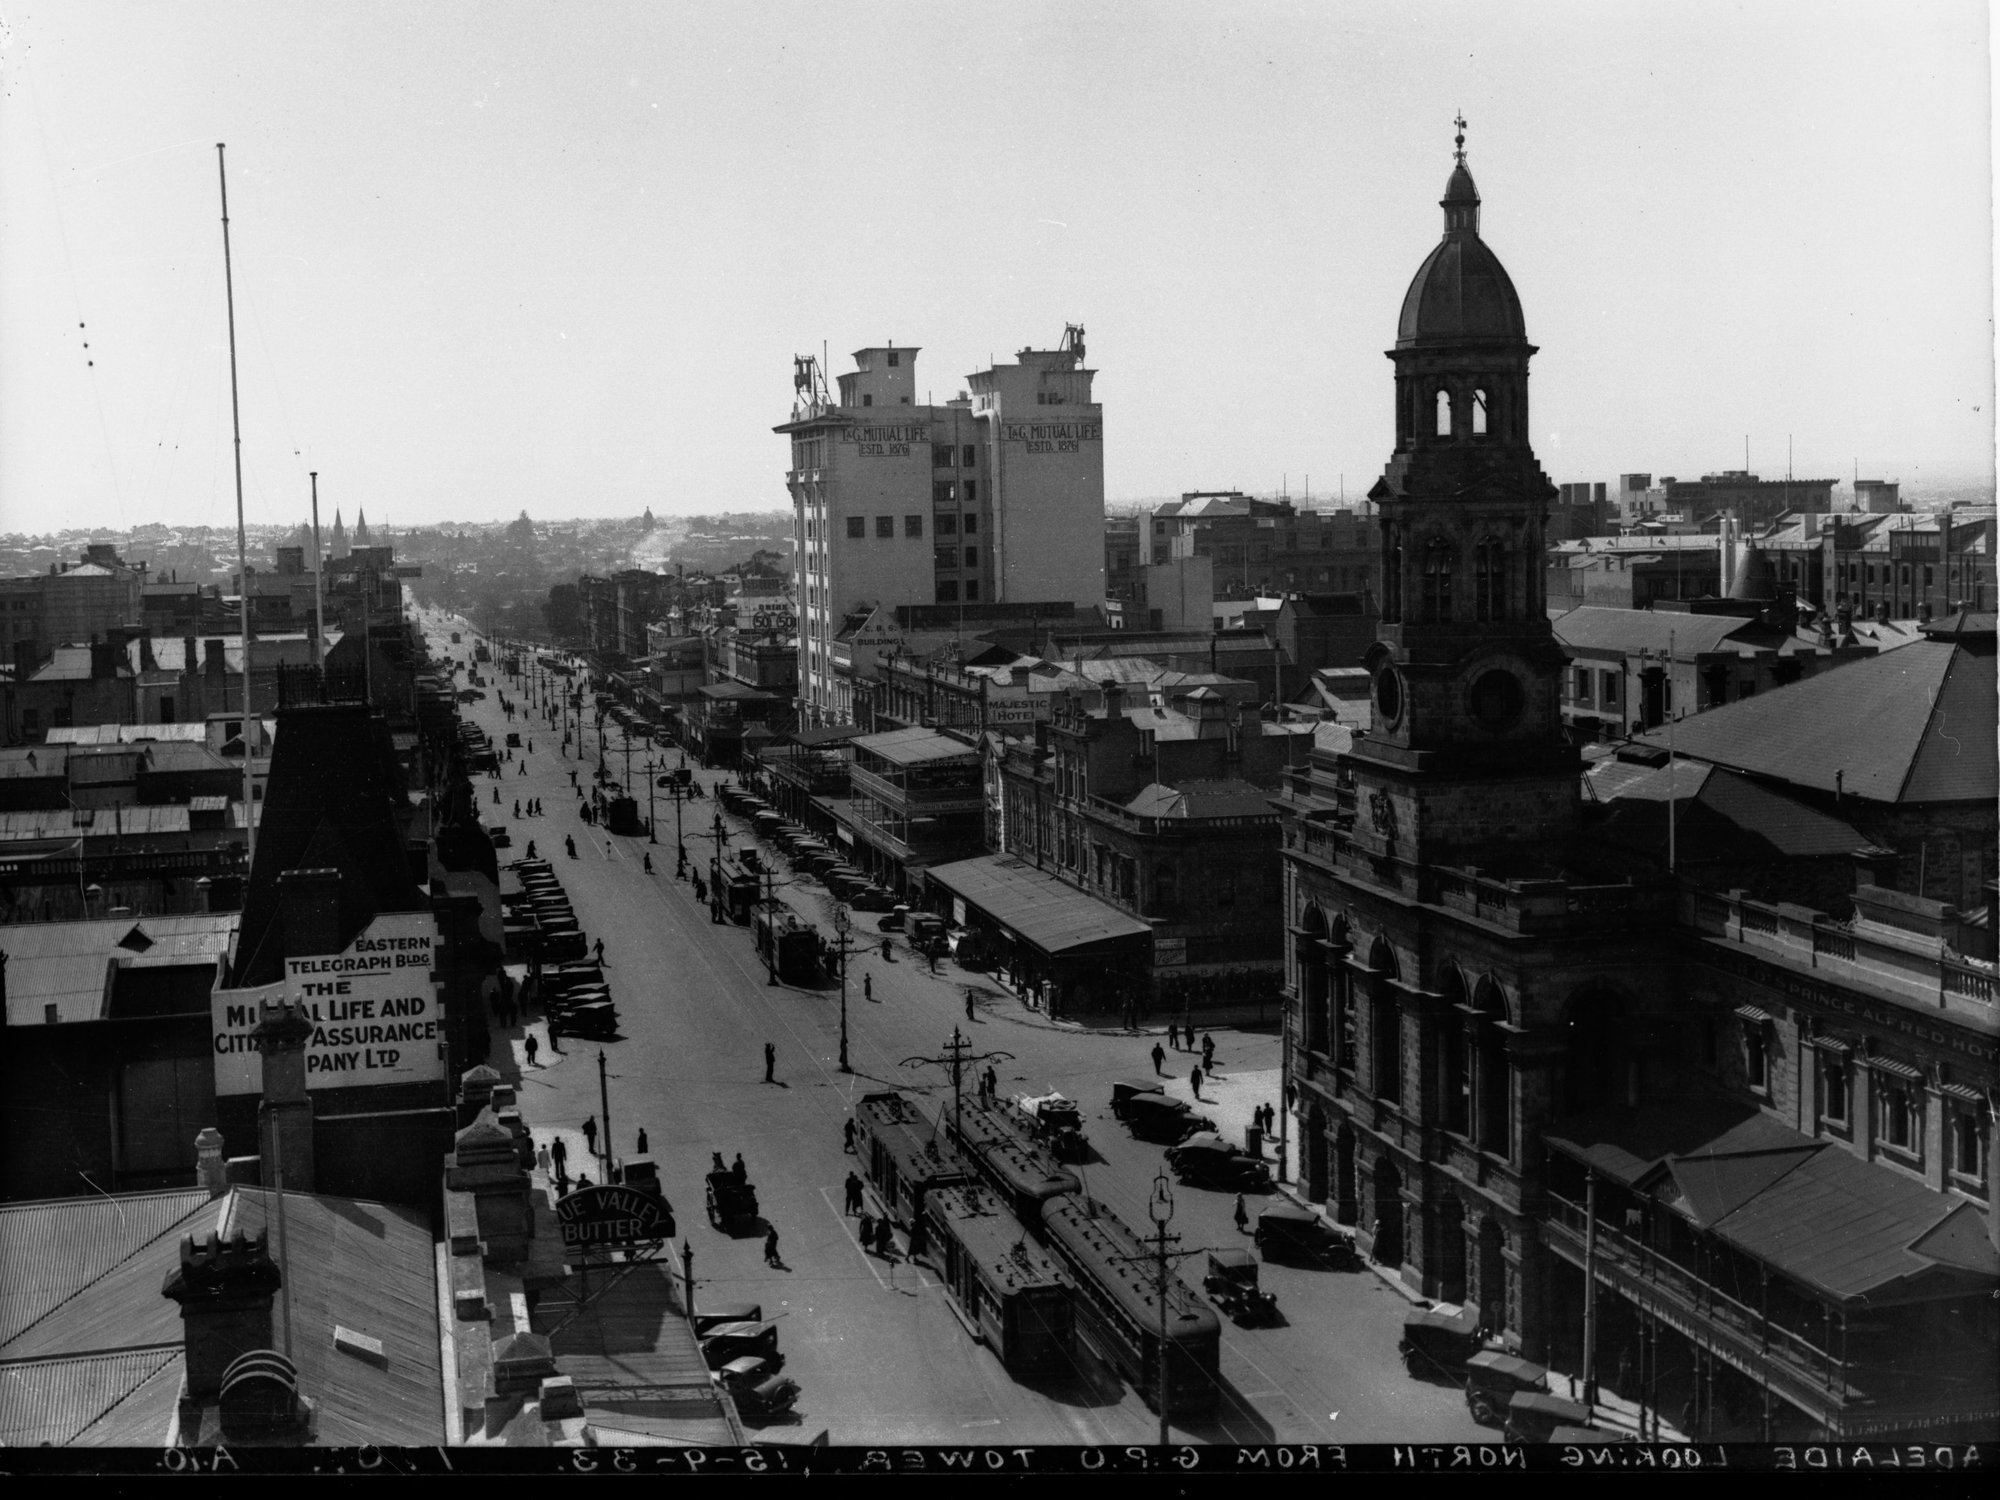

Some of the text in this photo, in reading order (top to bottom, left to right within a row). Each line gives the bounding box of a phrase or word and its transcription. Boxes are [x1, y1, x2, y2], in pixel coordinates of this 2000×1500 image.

[1030, 425, 1073, 439] MUTUAL
[1058, 440, 1079, 451] 1876
[857, 638, 900, 646] BUILDING
[988, 700, 1048, 709] MAJESTIC
[356, 937, 430, 953] EASTERN
[289, 956, 391, 974] TELEGRAPH
[302, 981, 351, 997] THE
[329, 999, 376, 1022] LIFE
[380, 996, 426, 1018] AND
[1790, 984, 1856, 1013] PRINCE
[1862, 1008, 1945, 1045] ALFRED
[311, 1021, 437, 1048] ASSURANCE
[595, 1190, 669, 1229] VALLEY
[564, 1218, 643, 1241] BUTTER
